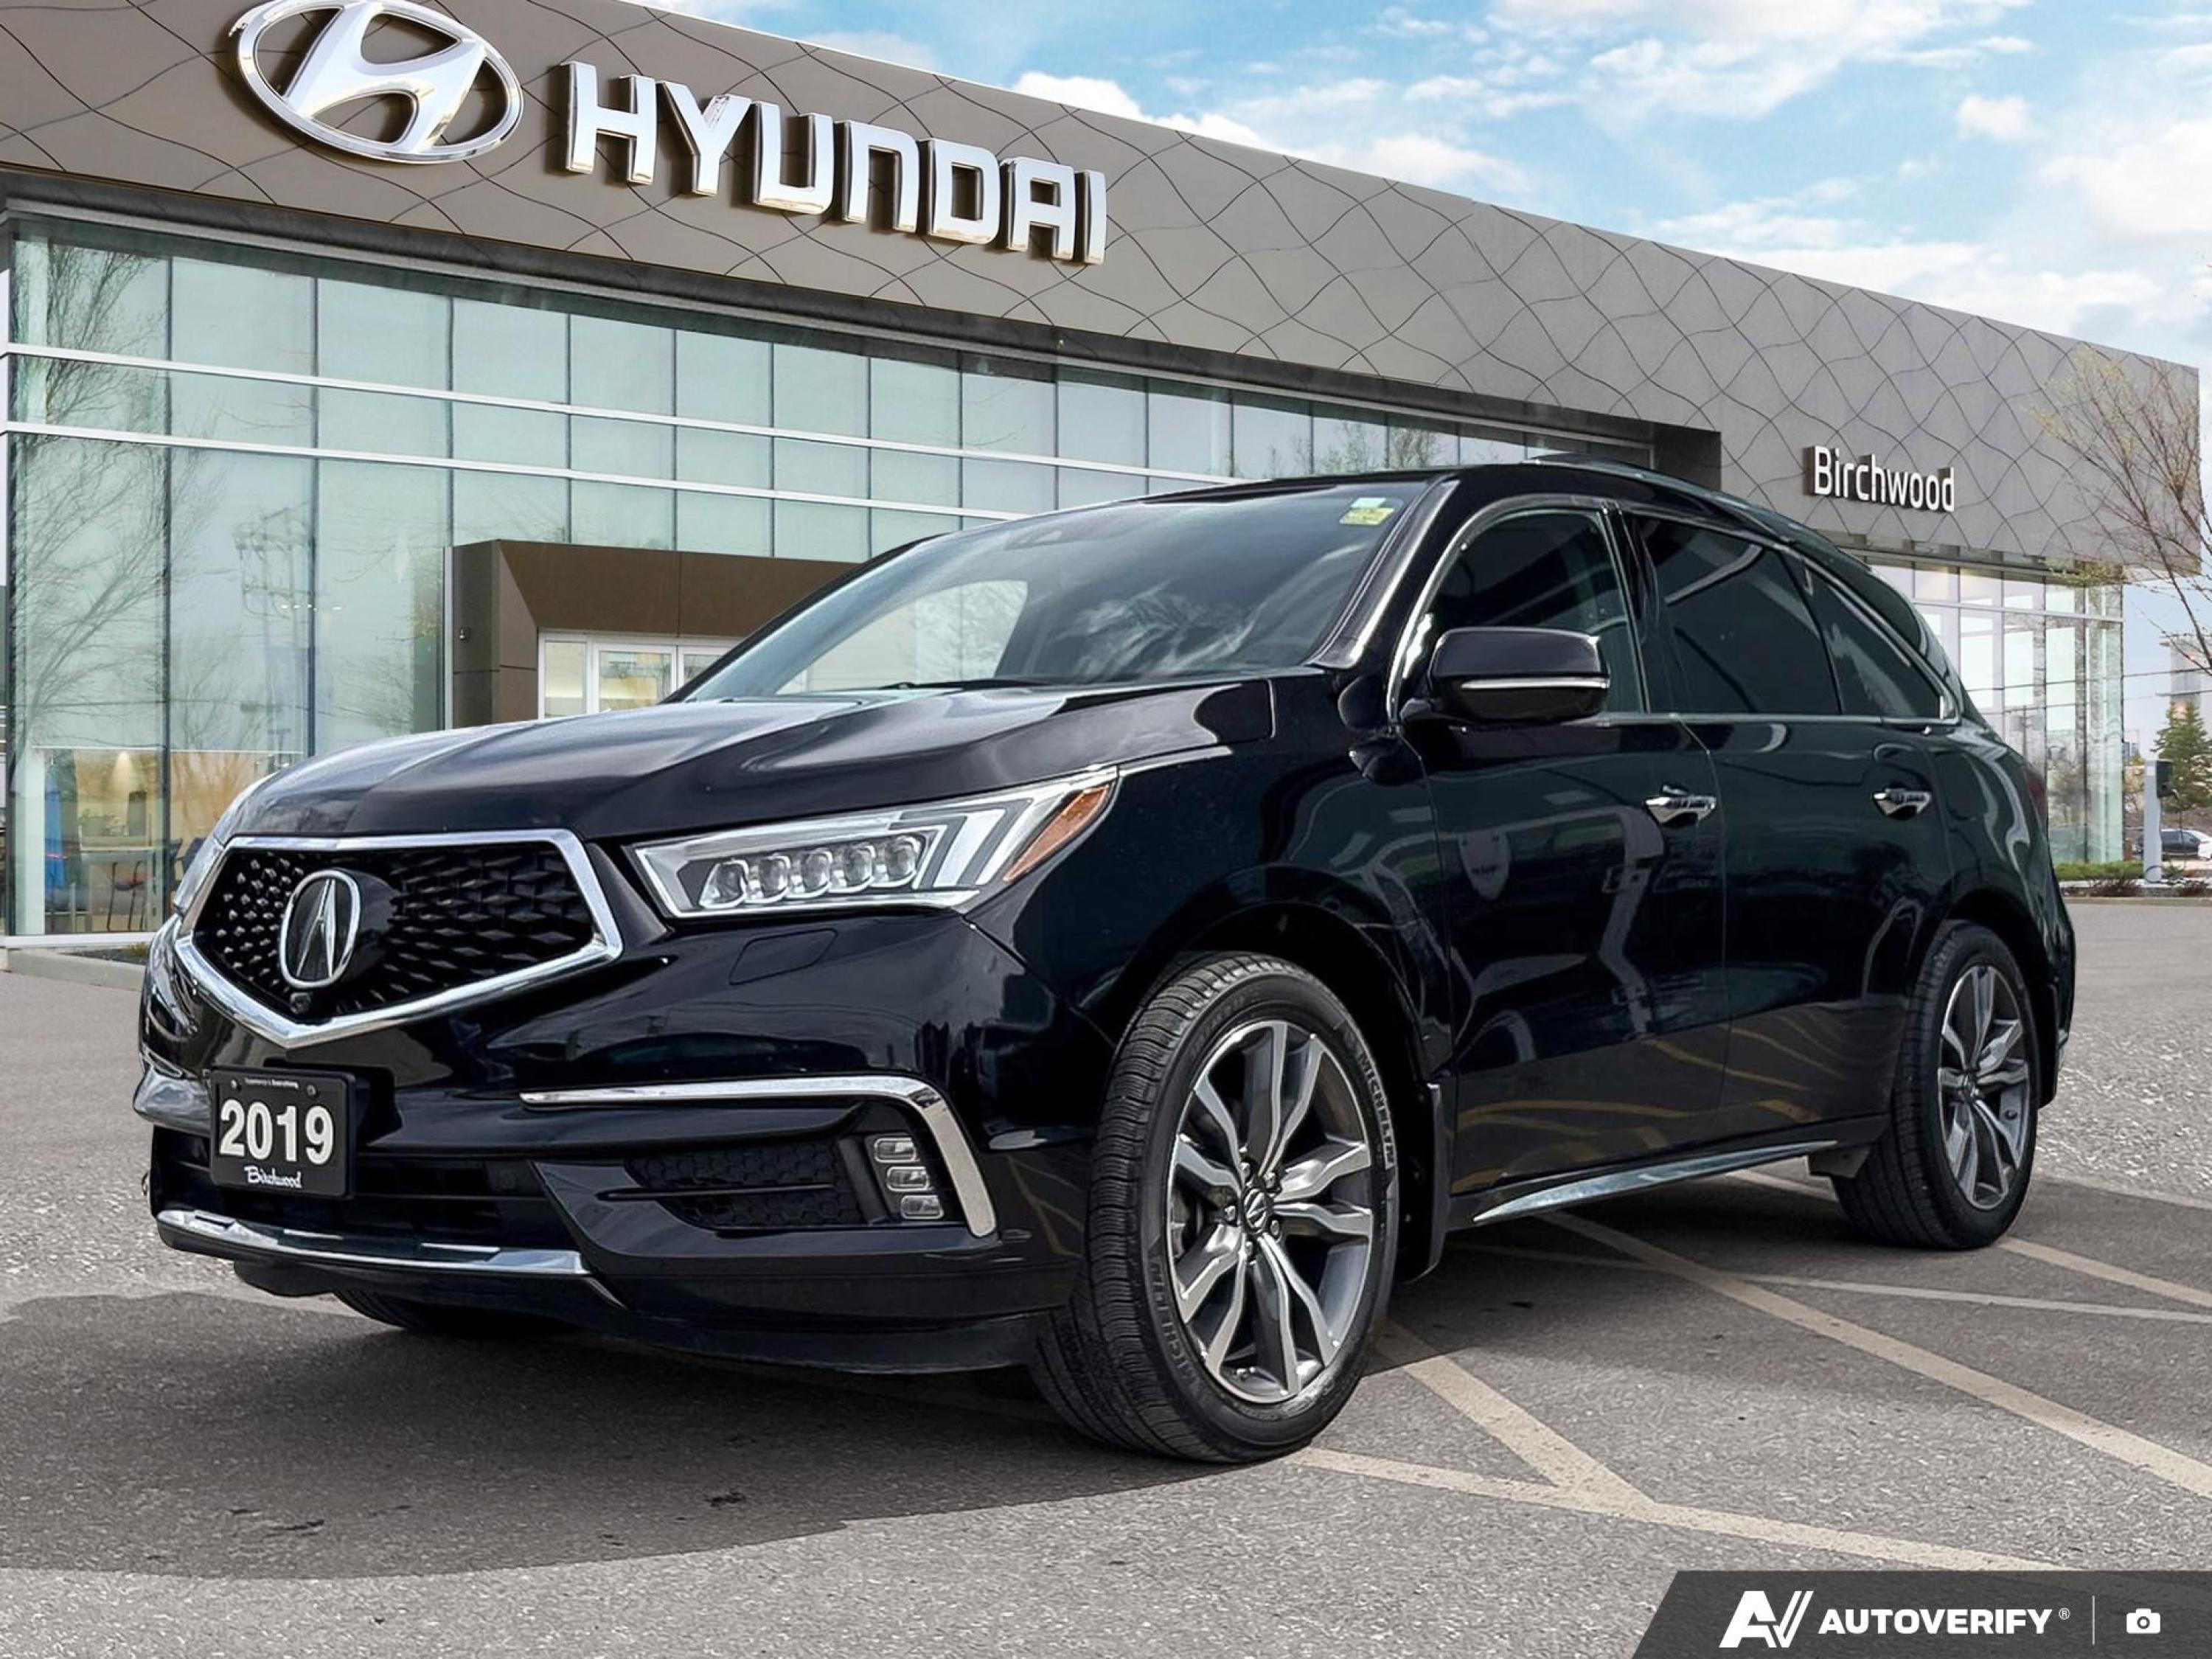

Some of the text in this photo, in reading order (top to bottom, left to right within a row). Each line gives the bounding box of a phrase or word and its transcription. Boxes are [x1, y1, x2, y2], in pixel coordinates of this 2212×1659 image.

[563, 60, 1107, 265] HYUNDAI
[1812, 445, 1954, 512] Birchwood
[220, 1099, 333, 1165] 2019
